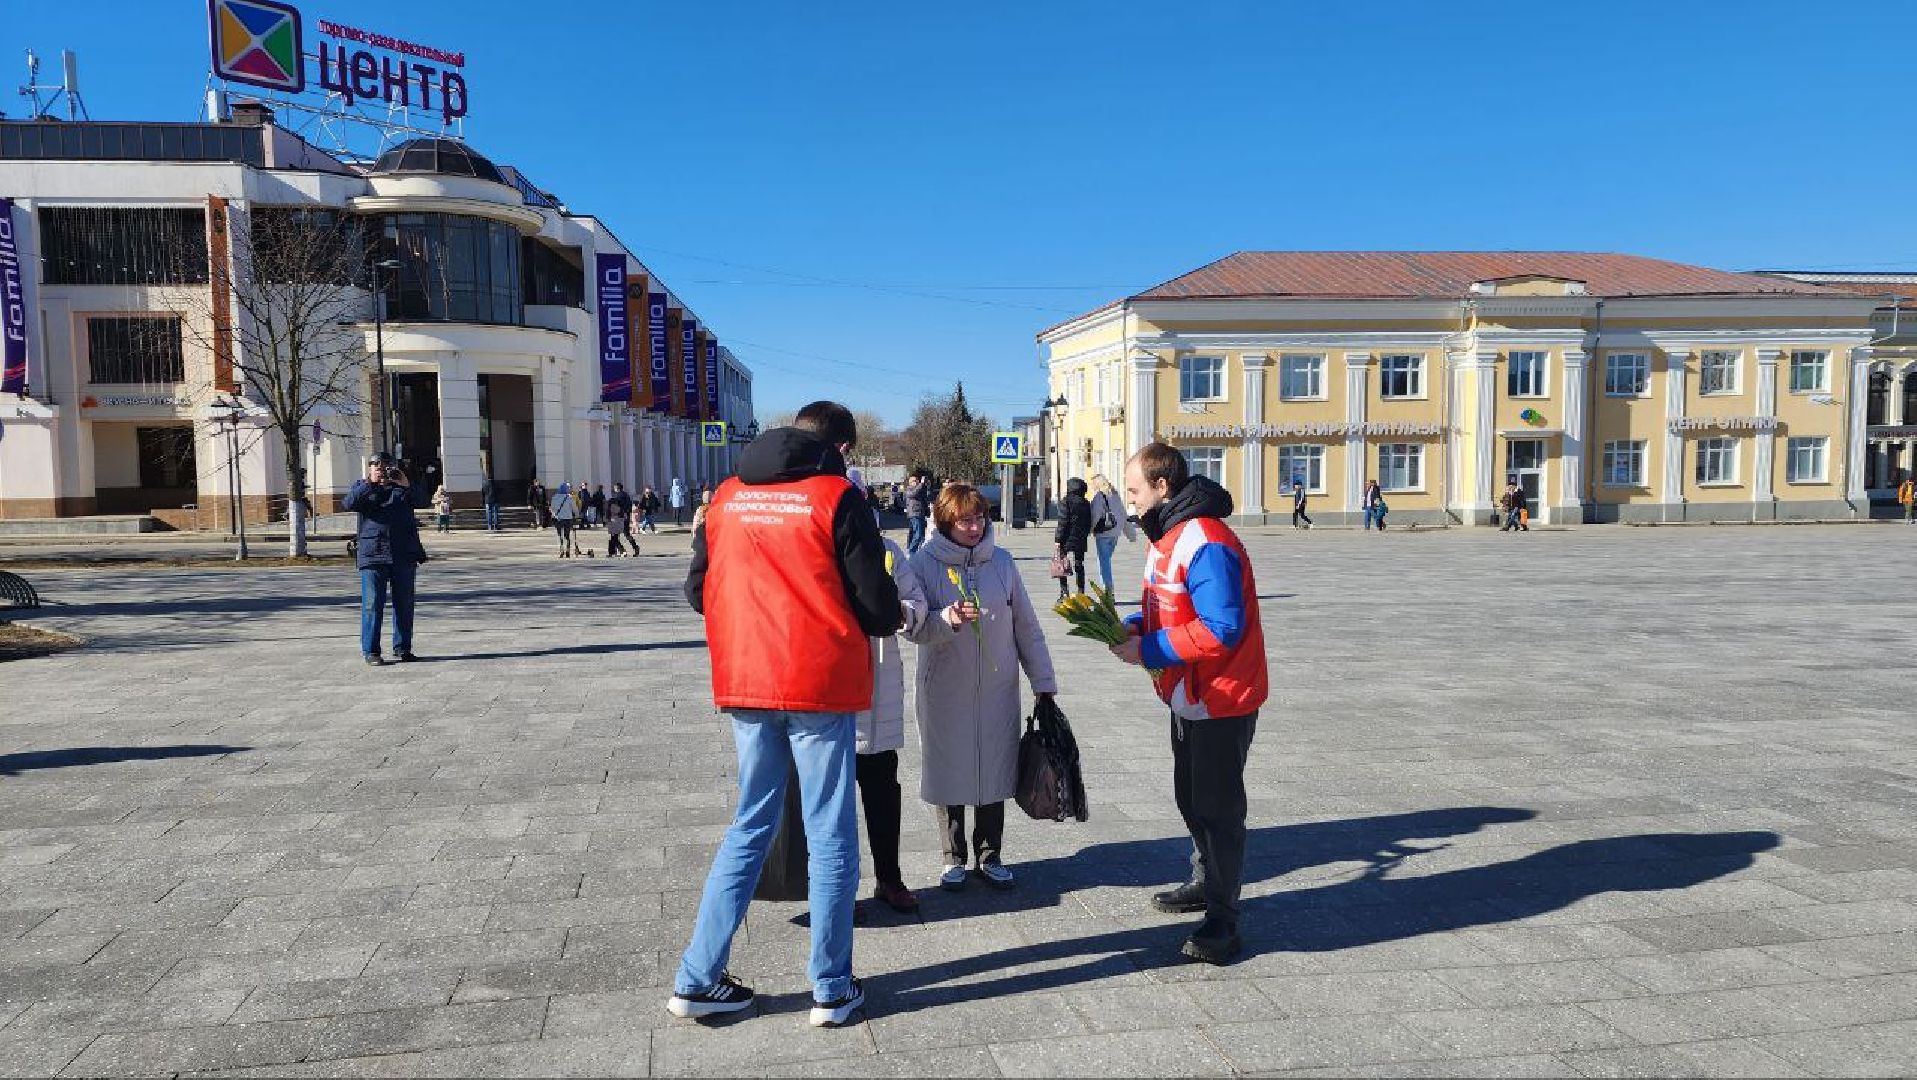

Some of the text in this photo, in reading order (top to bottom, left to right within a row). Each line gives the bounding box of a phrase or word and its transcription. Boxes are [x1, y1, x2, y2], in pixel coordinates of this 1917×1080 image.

[602, 267, 625, 361] familia
[649, 304, 666, 379] familia
[1668, 416, 1778, 432] ЦЕНТР ОПТИКИ
